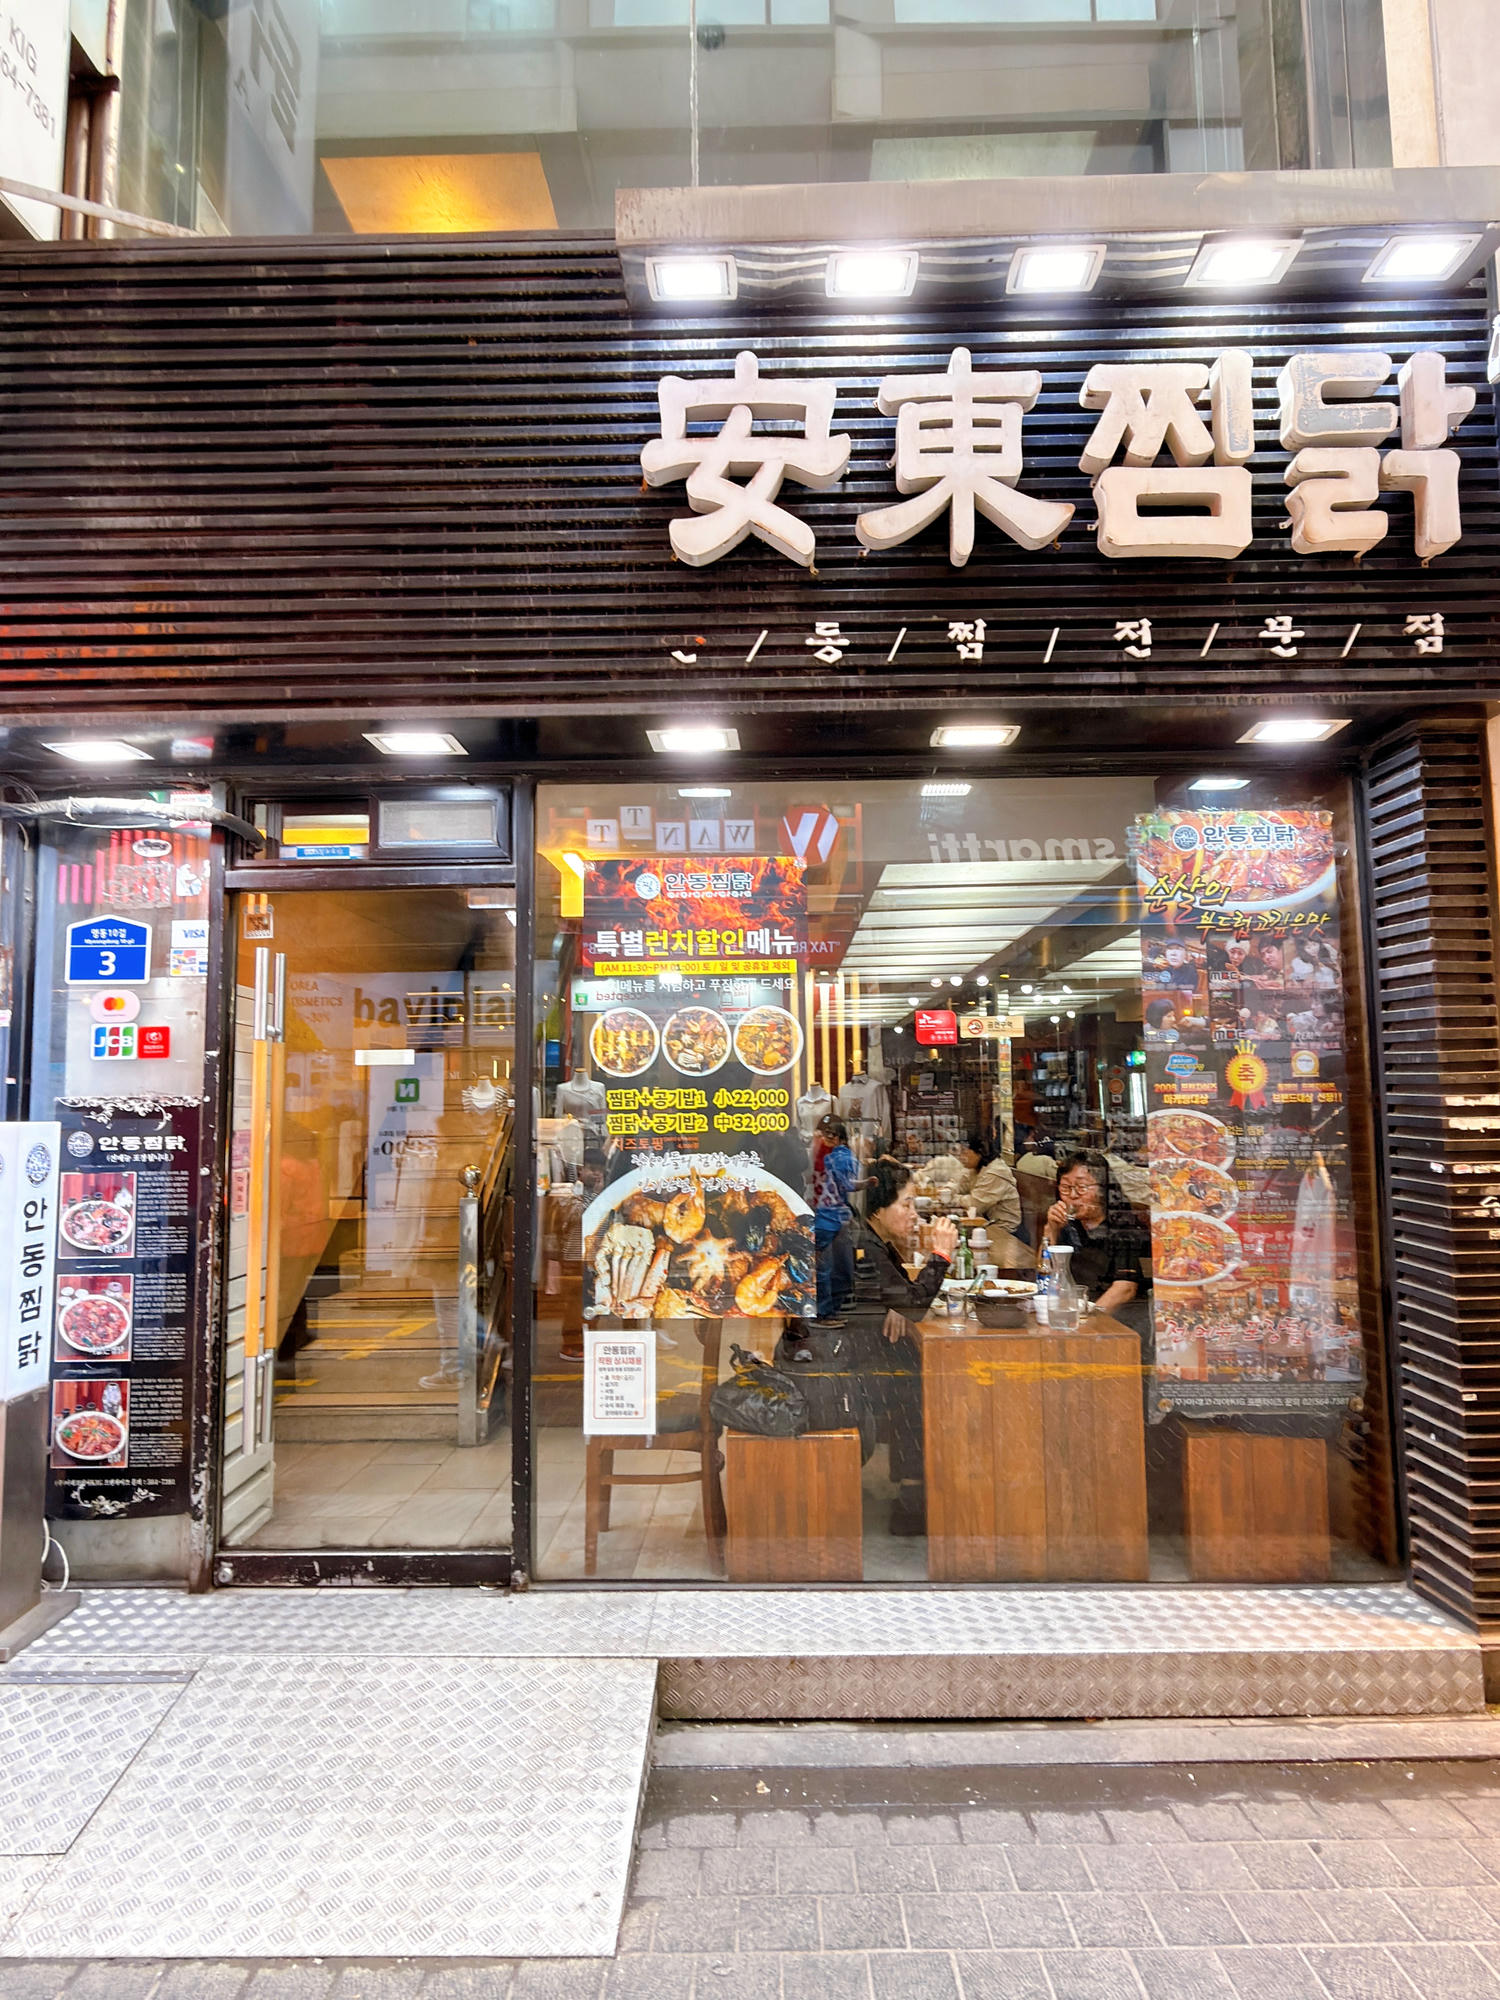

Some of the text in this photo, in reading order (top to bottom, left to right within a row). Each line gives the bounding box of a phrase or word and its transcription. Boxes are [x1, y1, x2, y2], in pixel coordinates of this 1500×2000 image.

[0, 50, 56, 139] 64-7381
[1203, 825, 1296, 843] 안동찜닭
[665, 872, 754, 891] 안동찜닭
[1145, 874, 1231, 924] 순살의
[183, 929, 206, 938] VISA
[98, 951, 116, 976] 3
[761, 976, 795, 991] 드세요
[98, 1135, 187, 1151] 안동찜닭
[18, 1197, 47, 1368] 안동찜닭
